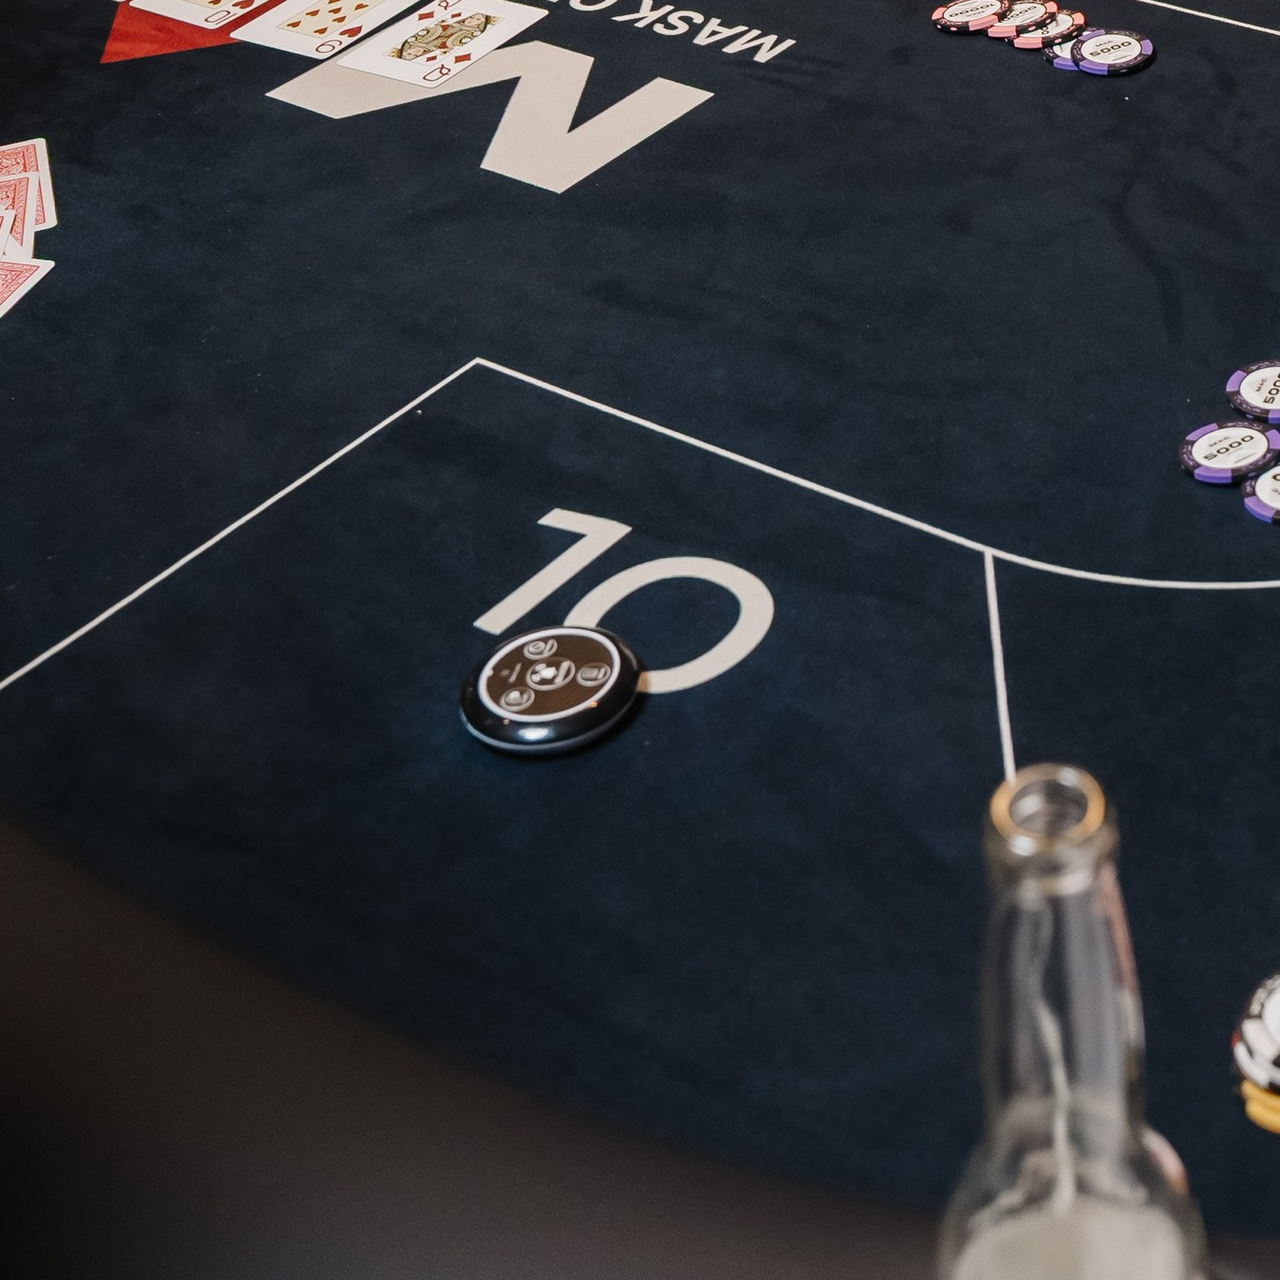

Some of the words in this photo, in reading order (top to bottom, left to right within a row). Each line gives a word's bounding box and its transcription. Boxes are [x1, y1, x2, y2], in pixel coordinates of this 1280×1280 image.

[204, 9, 232, 26] 10
[1089, 40, 1132, 57] 5000
[423, 64, 451, 82] Q
[1203, 434, 1255, 461] 5000
[472, 507, 775, 695] 10
